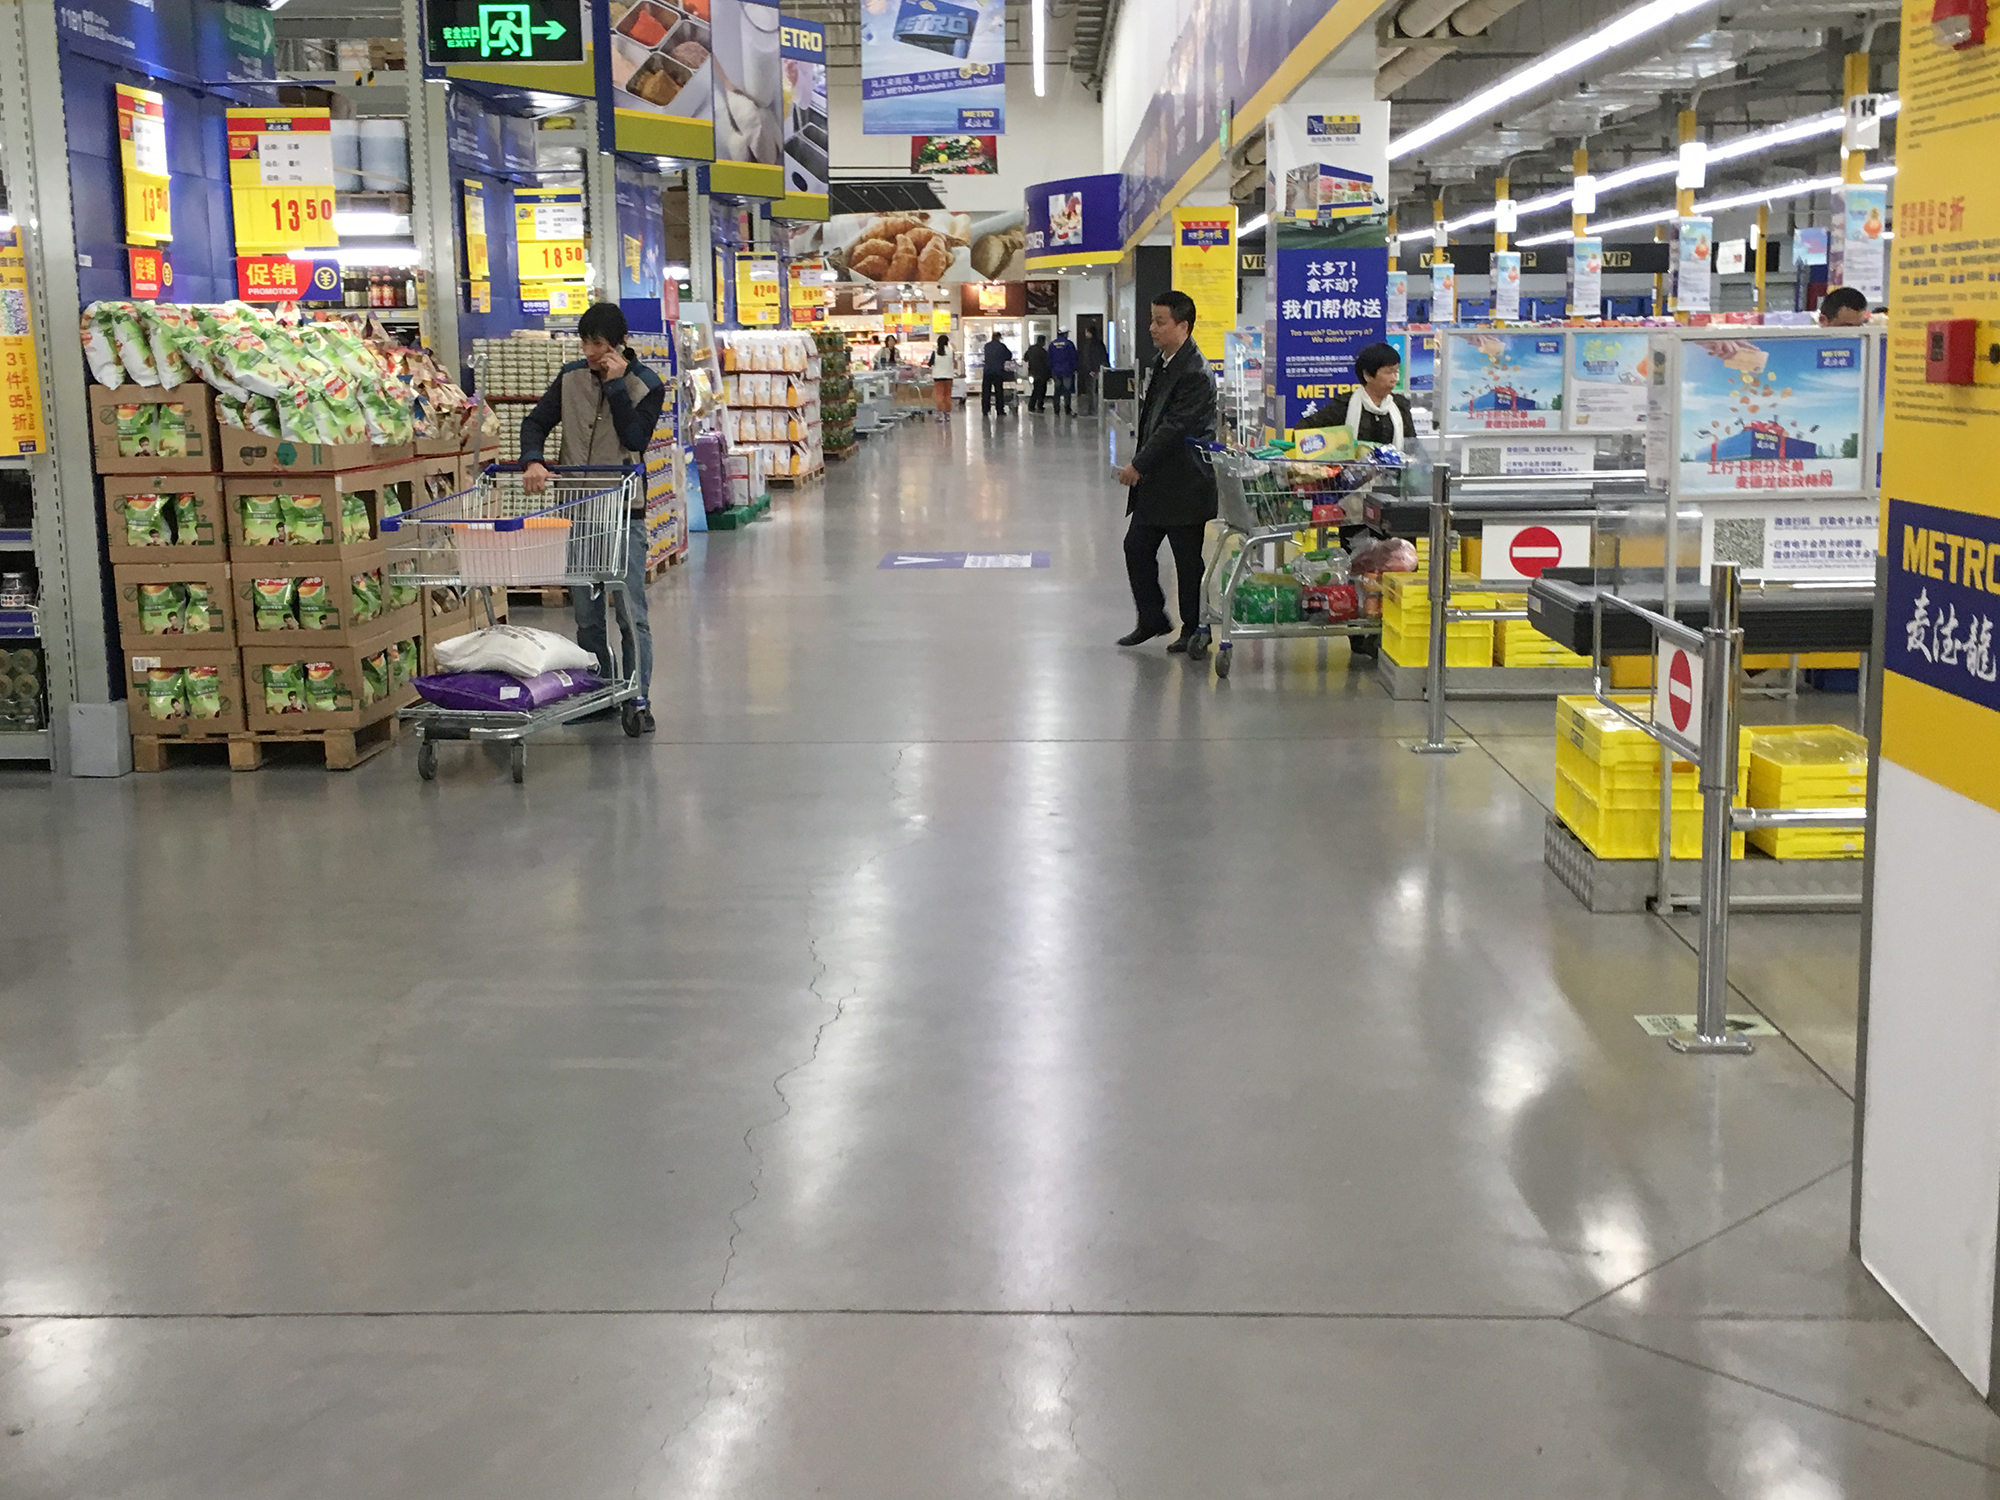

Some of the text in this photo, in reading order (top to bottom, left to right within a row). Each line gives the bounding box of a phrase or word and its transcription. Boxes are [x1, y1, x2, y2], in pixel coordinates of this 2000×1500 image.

[442, 26, 480, 39] 安全出口
[781, 26, 823, 52] ETRO
[446, 40, 477, 48] EXIT
[1603, 253, 1630, 267] VIP
[133, 256, 156, 281] 促销
[246, 262, 297, 286] 促销
[247, 287, 298, 295] PROMOTION
[1281, 298, 1382, 320] 我们帮你送
[1324, 335, 1347, 343] deliver
[1707, 459, 1804, 475] 工行卡积分买单
[1736, 471, 1833, 489] 麦德龙极致畅购
